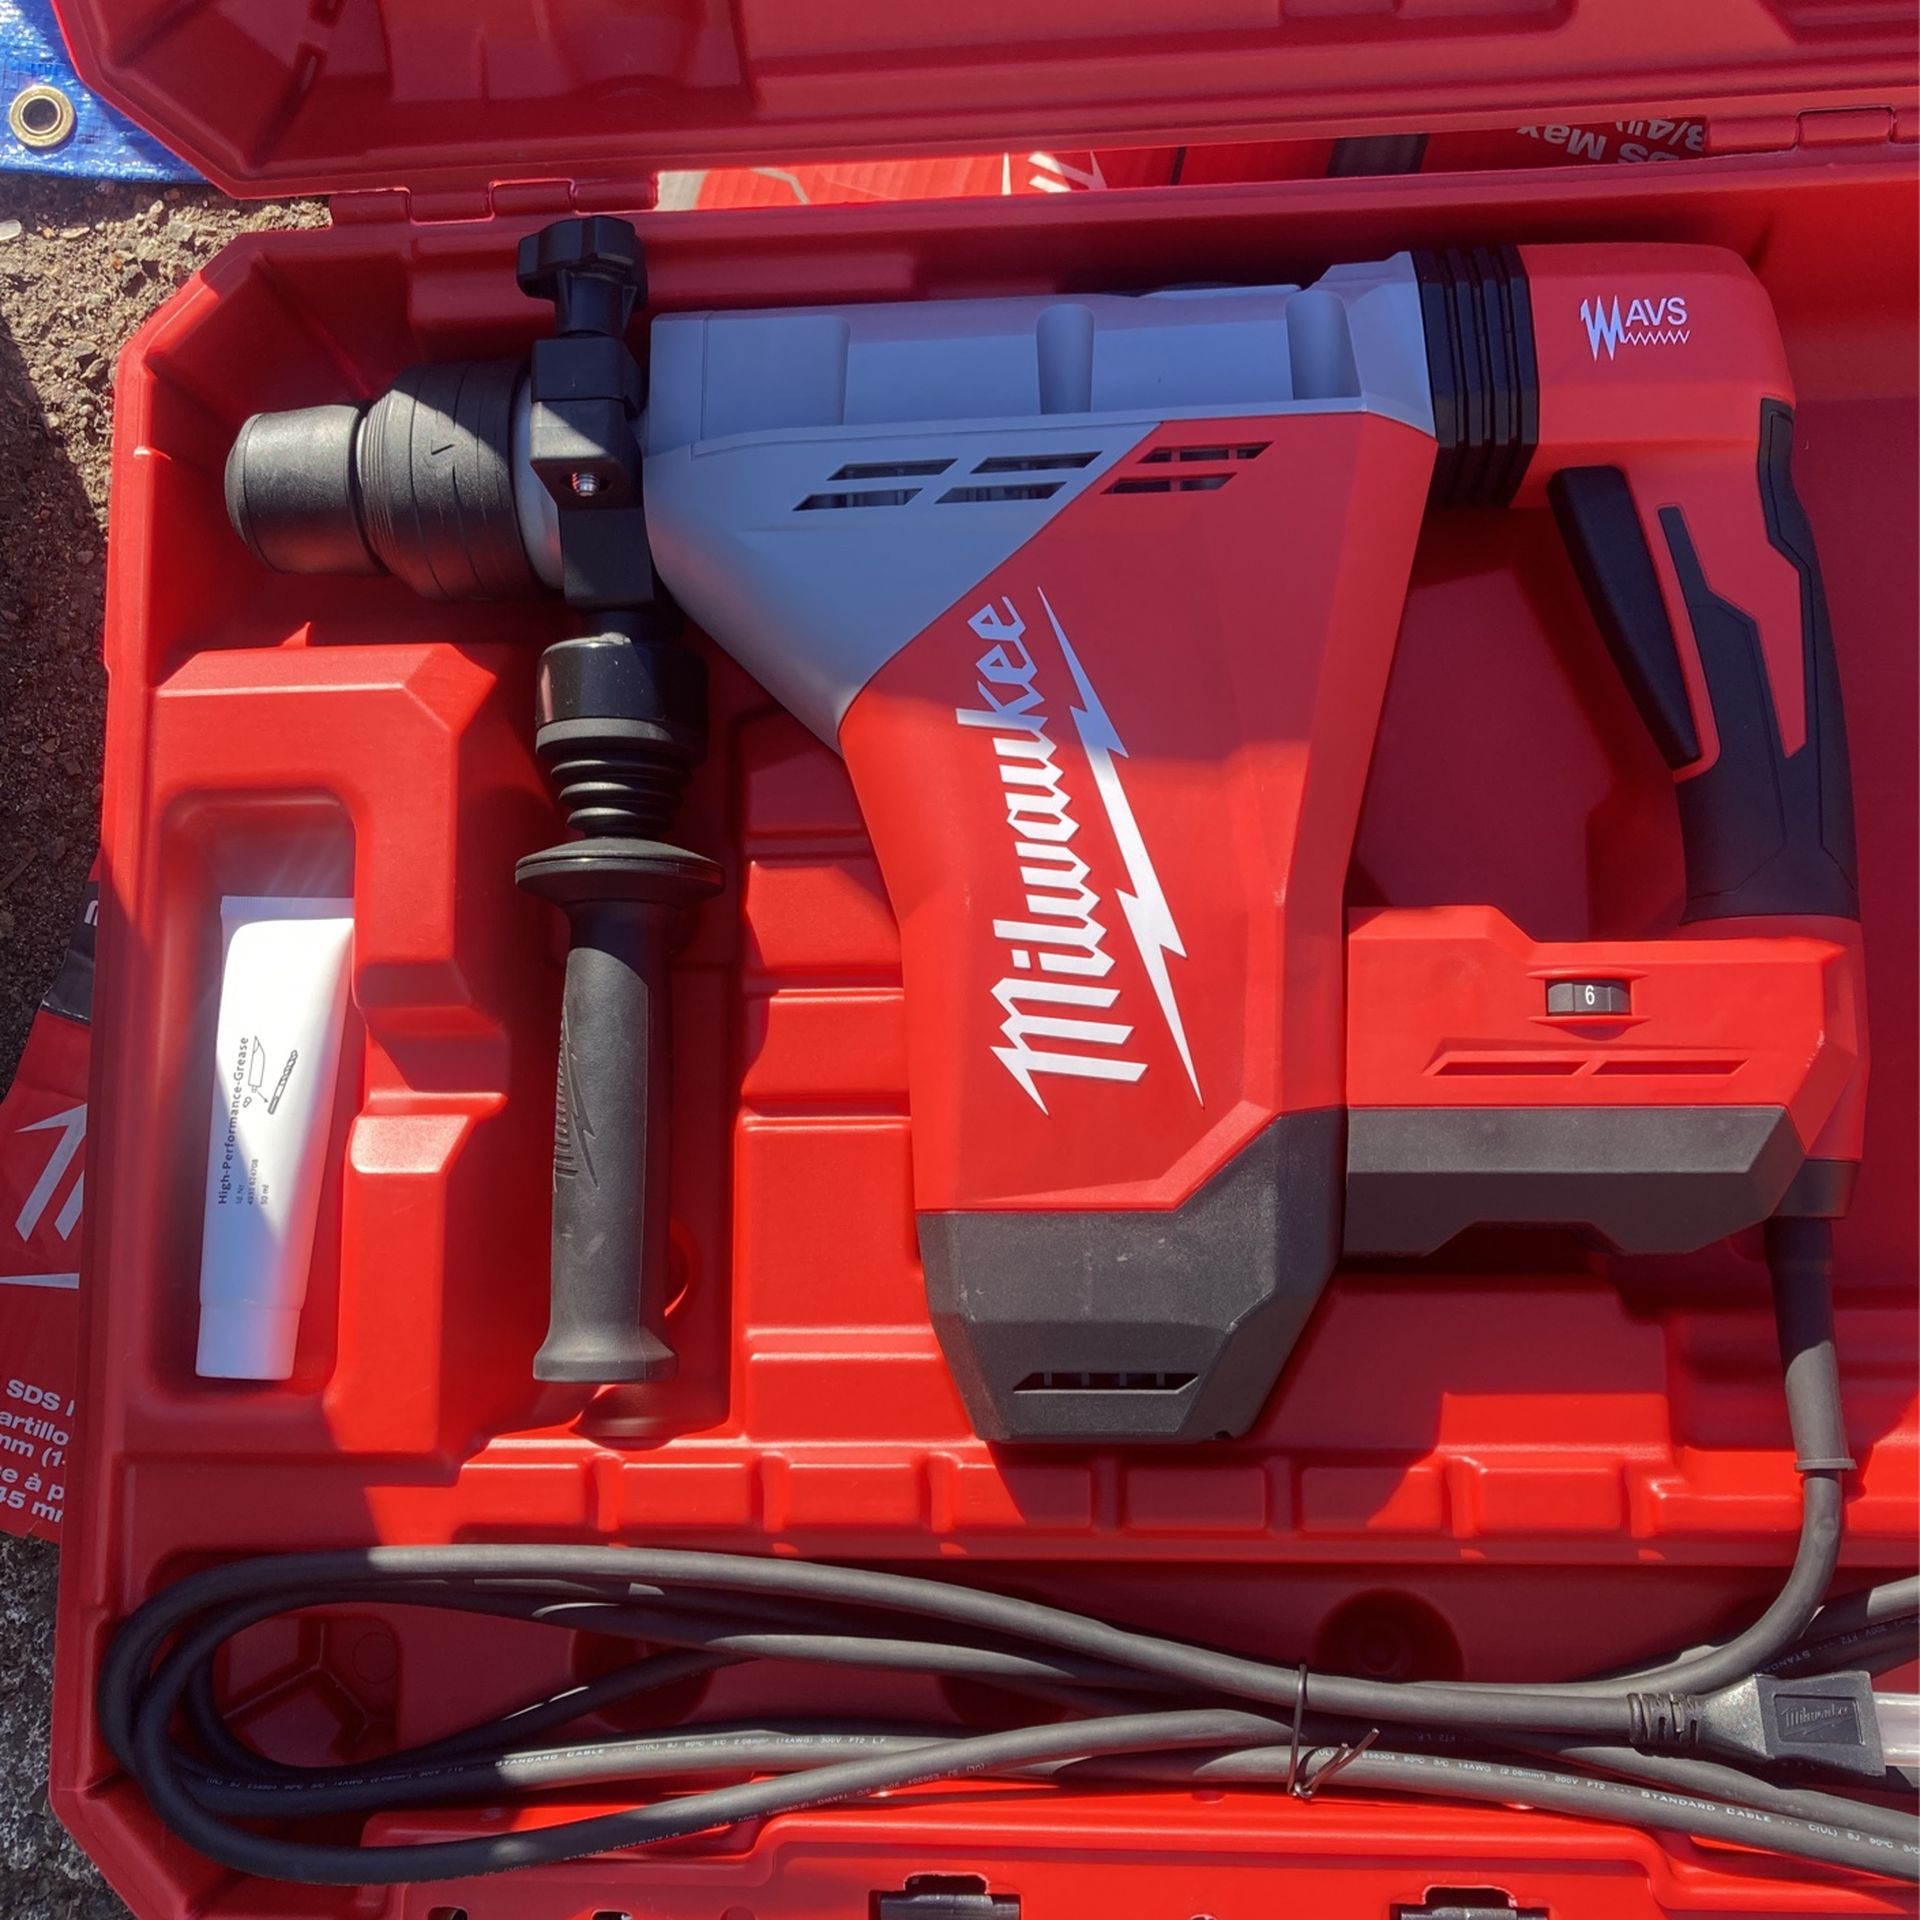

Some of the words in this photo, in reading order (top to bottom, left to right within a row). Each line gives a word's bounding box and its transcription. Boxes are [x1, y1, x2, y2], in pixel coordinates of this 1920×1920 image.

[1625, 296, 1688, 327] AVS
[955, 596, 1149, 1117] Milwaukee
[1584, 984, 1596, 1006] 6
[217, 1036, 249, 1205] High-Performance-Grease
[6, 1378, 61, 1411] SDS
[24, 1472, 42, 1493] à
[494, 1753, 559, 1767] STANDARD
[566, 1748, 604, 1758] CABLE
[1640, 1790, 1716, 1812] STANDARD
[1726, 1806, 1772, 1823] CABLE
